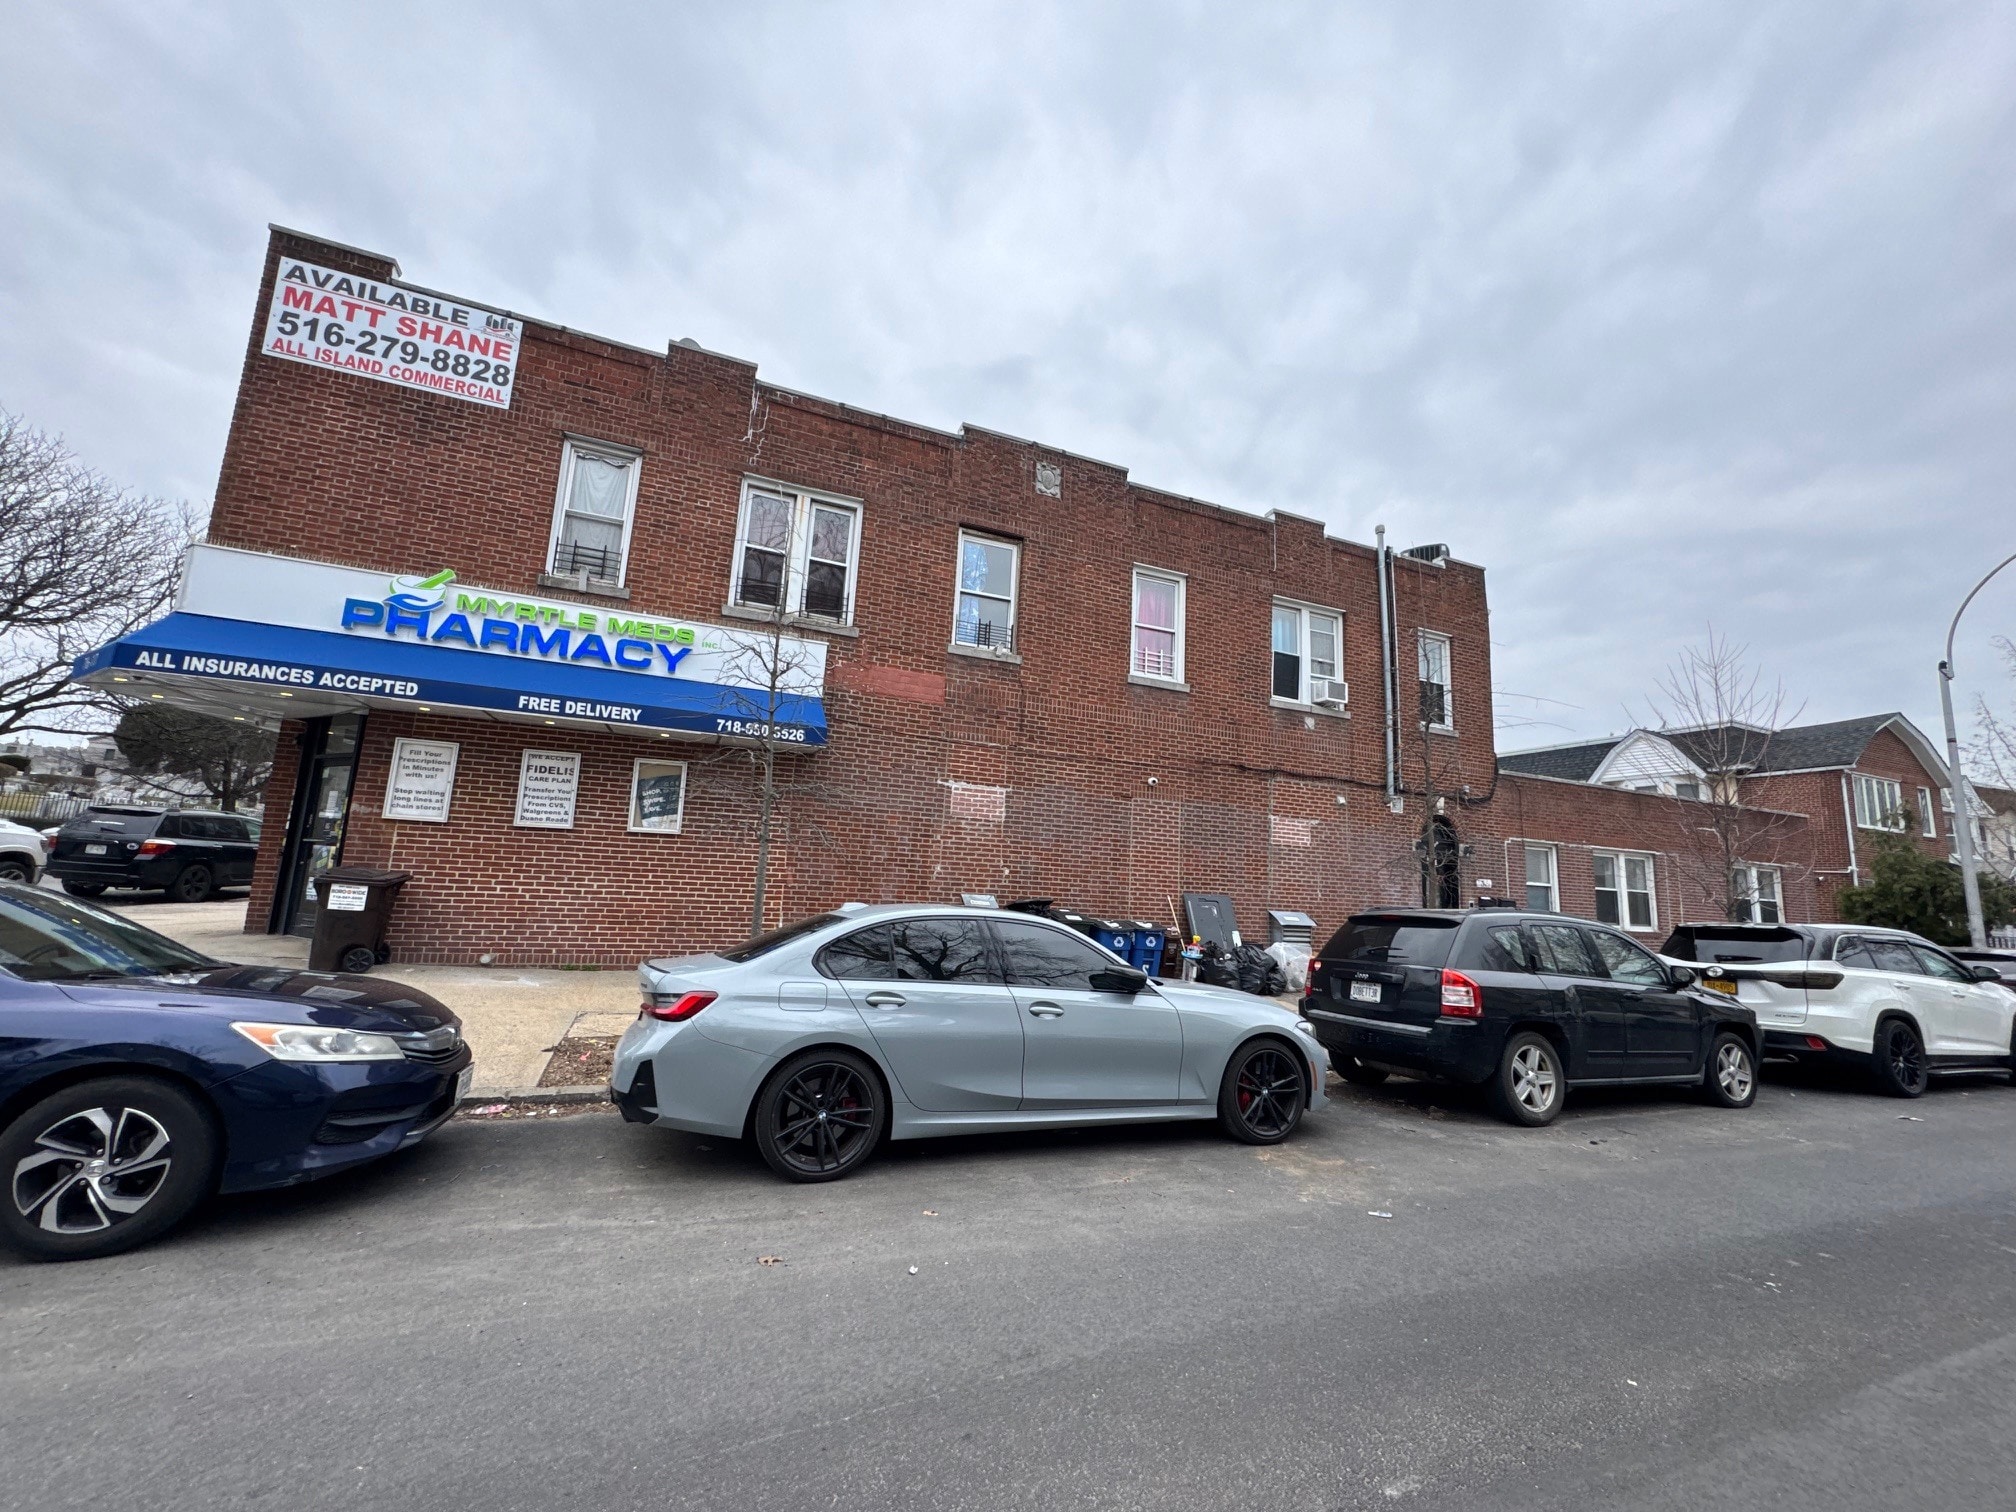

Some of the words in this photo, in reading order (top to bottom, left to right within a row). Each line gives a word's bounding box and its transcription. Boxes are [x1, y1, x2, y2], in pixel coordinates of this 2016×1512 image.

[282, 286, 386, 328] MATT
[396, 316, 513, 362] SHANE
[284, 264, 470, 327] AVAILABLE
[271, 337, 308, 358] ALL
[314, 346, 384, 374] ISLAND
[388, 365, 505, 402] COMMERCIAL
[277, 310, 511, 387] 516-279-8828
[341, 597, 692, 674] PHARMACY
[456, 593, 598, 632] MYRTLE
[607, 617, 696, 646] MEDS
[135, 651, 176, 669] ALL
[182, 655, 314, 684] INSURANCES
[318, 672, 419, 697] ACCEPTED
[518, 695, 561, 713] FREE
[564, 701, 642, 722] DELIVERY
[415, 789, 446, 798] waiting
[526, 765, 575, 776] FIDELIS
